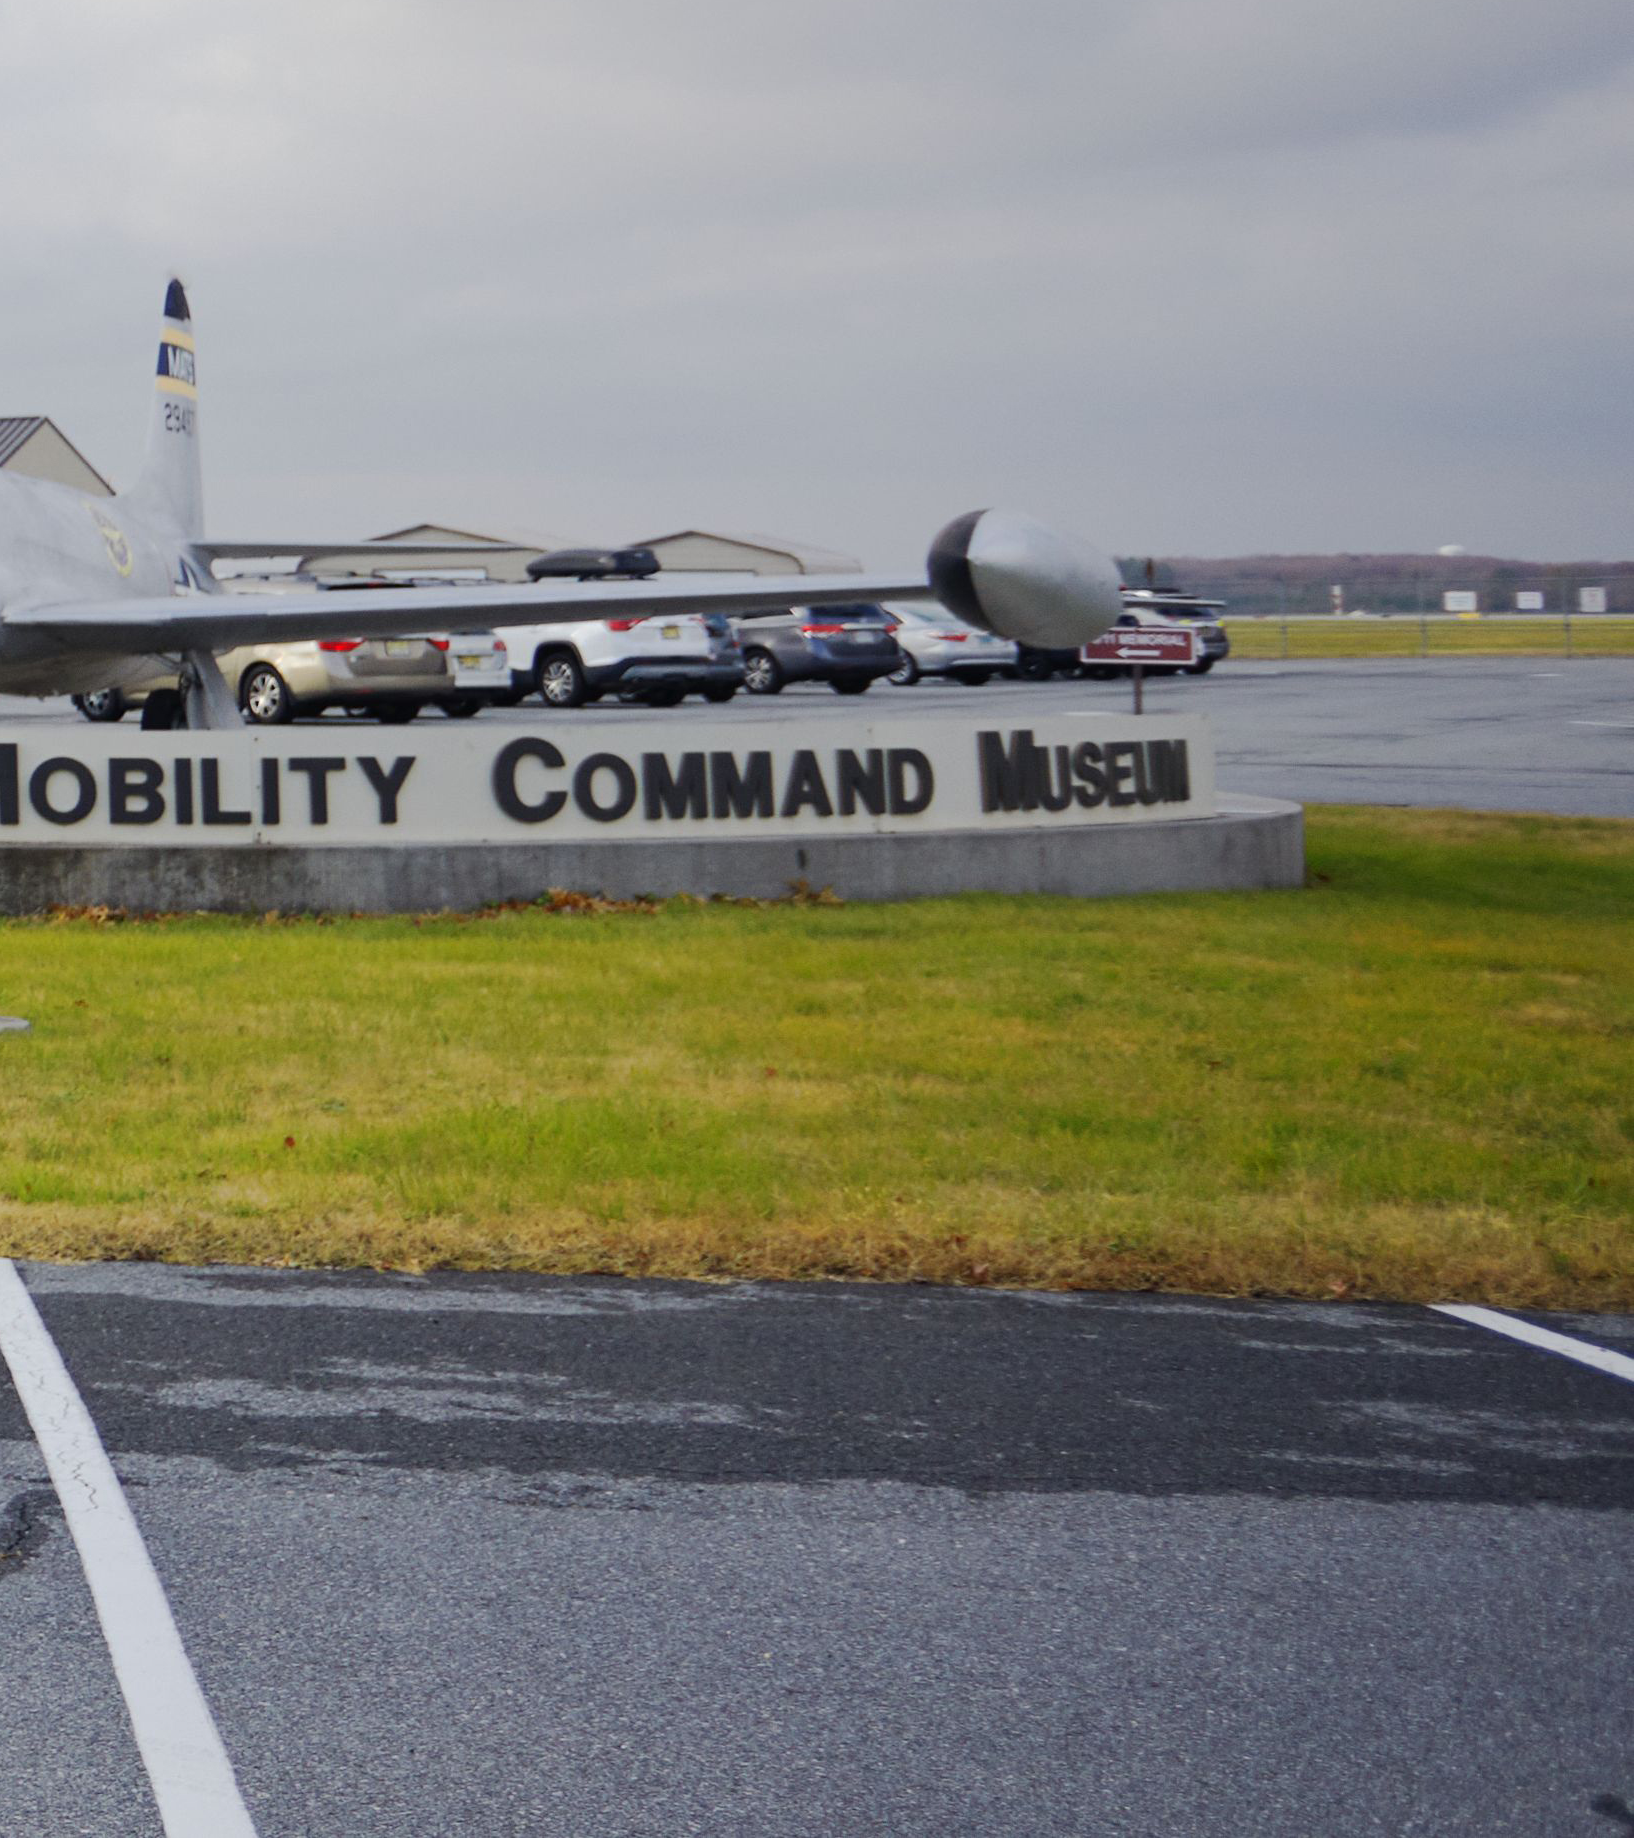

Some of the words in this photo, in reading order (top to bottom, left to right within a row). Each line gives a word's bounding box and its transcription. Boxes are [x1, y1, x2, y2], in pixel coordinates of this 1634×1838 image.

[1118, 633, 1186, 647] MEMORIAL
[491, 737, 935, 825] COMMAND
[977, 729, 1191, 815] MUSEUM
